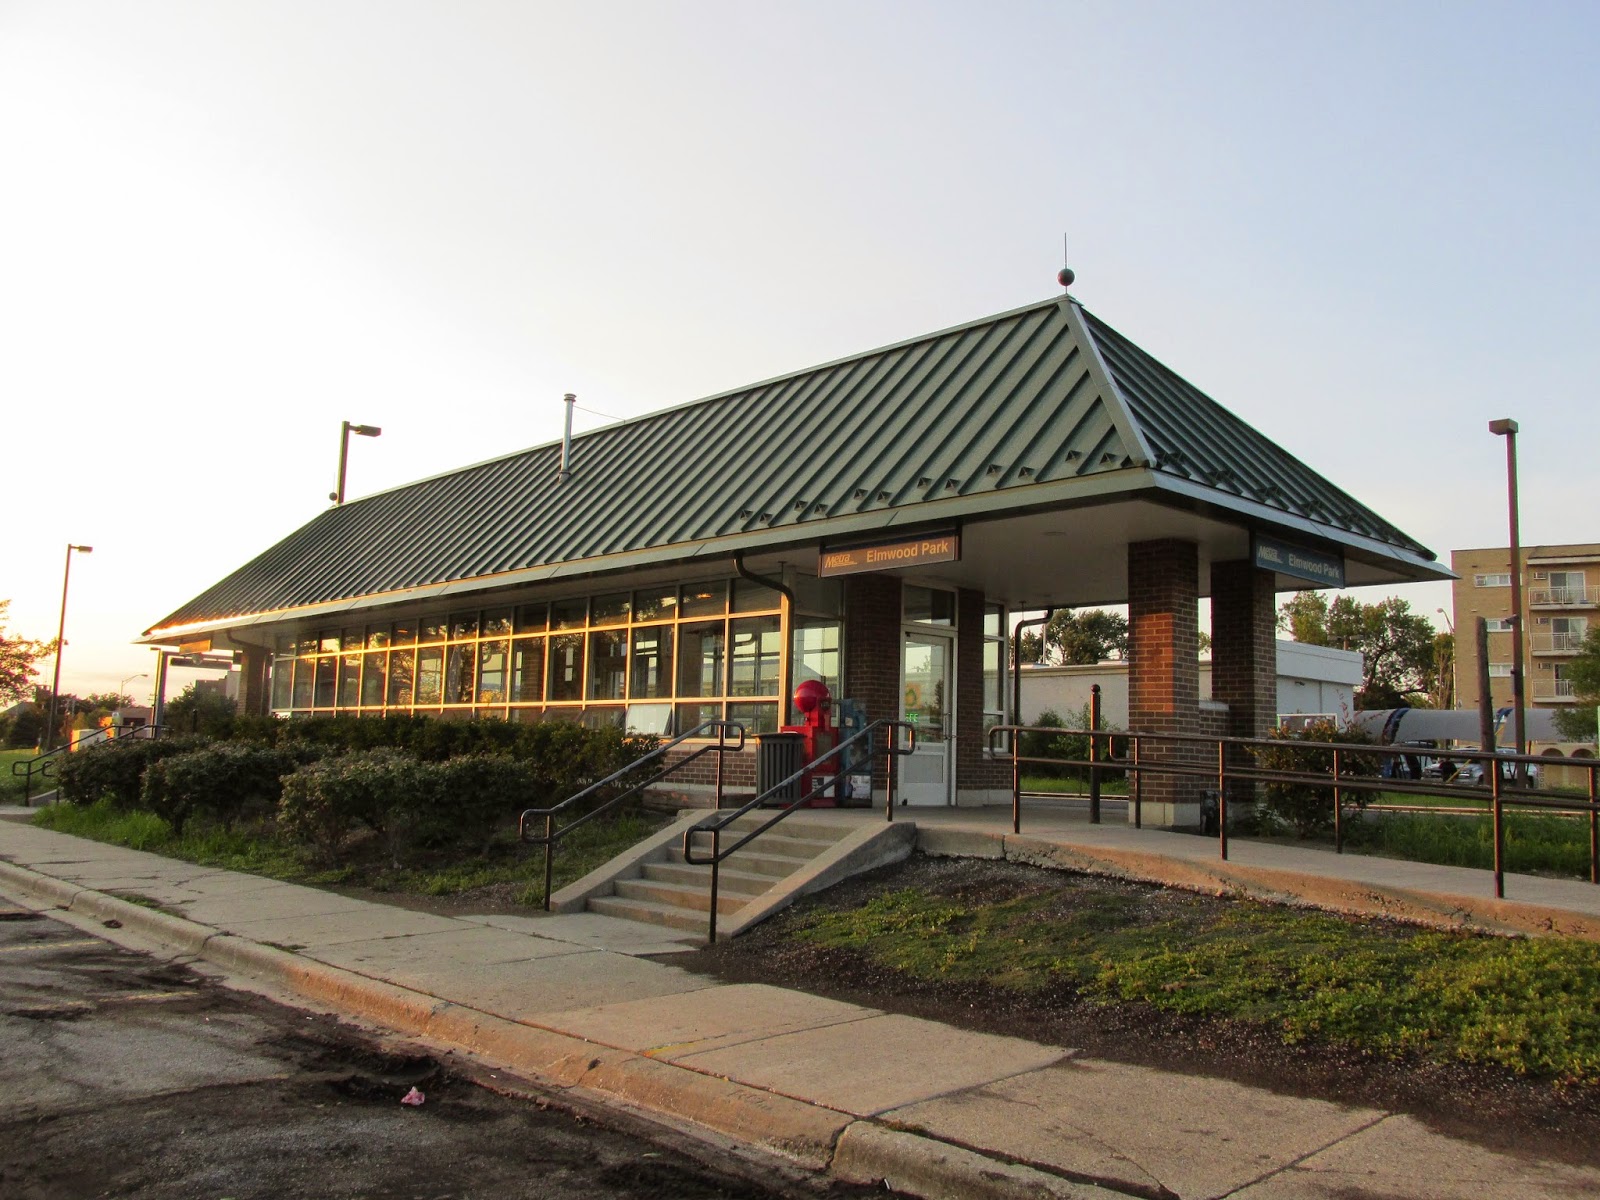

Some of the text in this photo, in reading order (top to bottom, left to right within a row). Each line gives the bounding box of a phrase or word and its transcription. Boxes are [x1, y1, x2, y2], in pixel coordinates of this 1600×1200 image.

[825, 553, 857, 568] Metra
[866, 541, 949, 563] Elmwood Park
[1288, 553, 1340, 579] Elmwood Park
